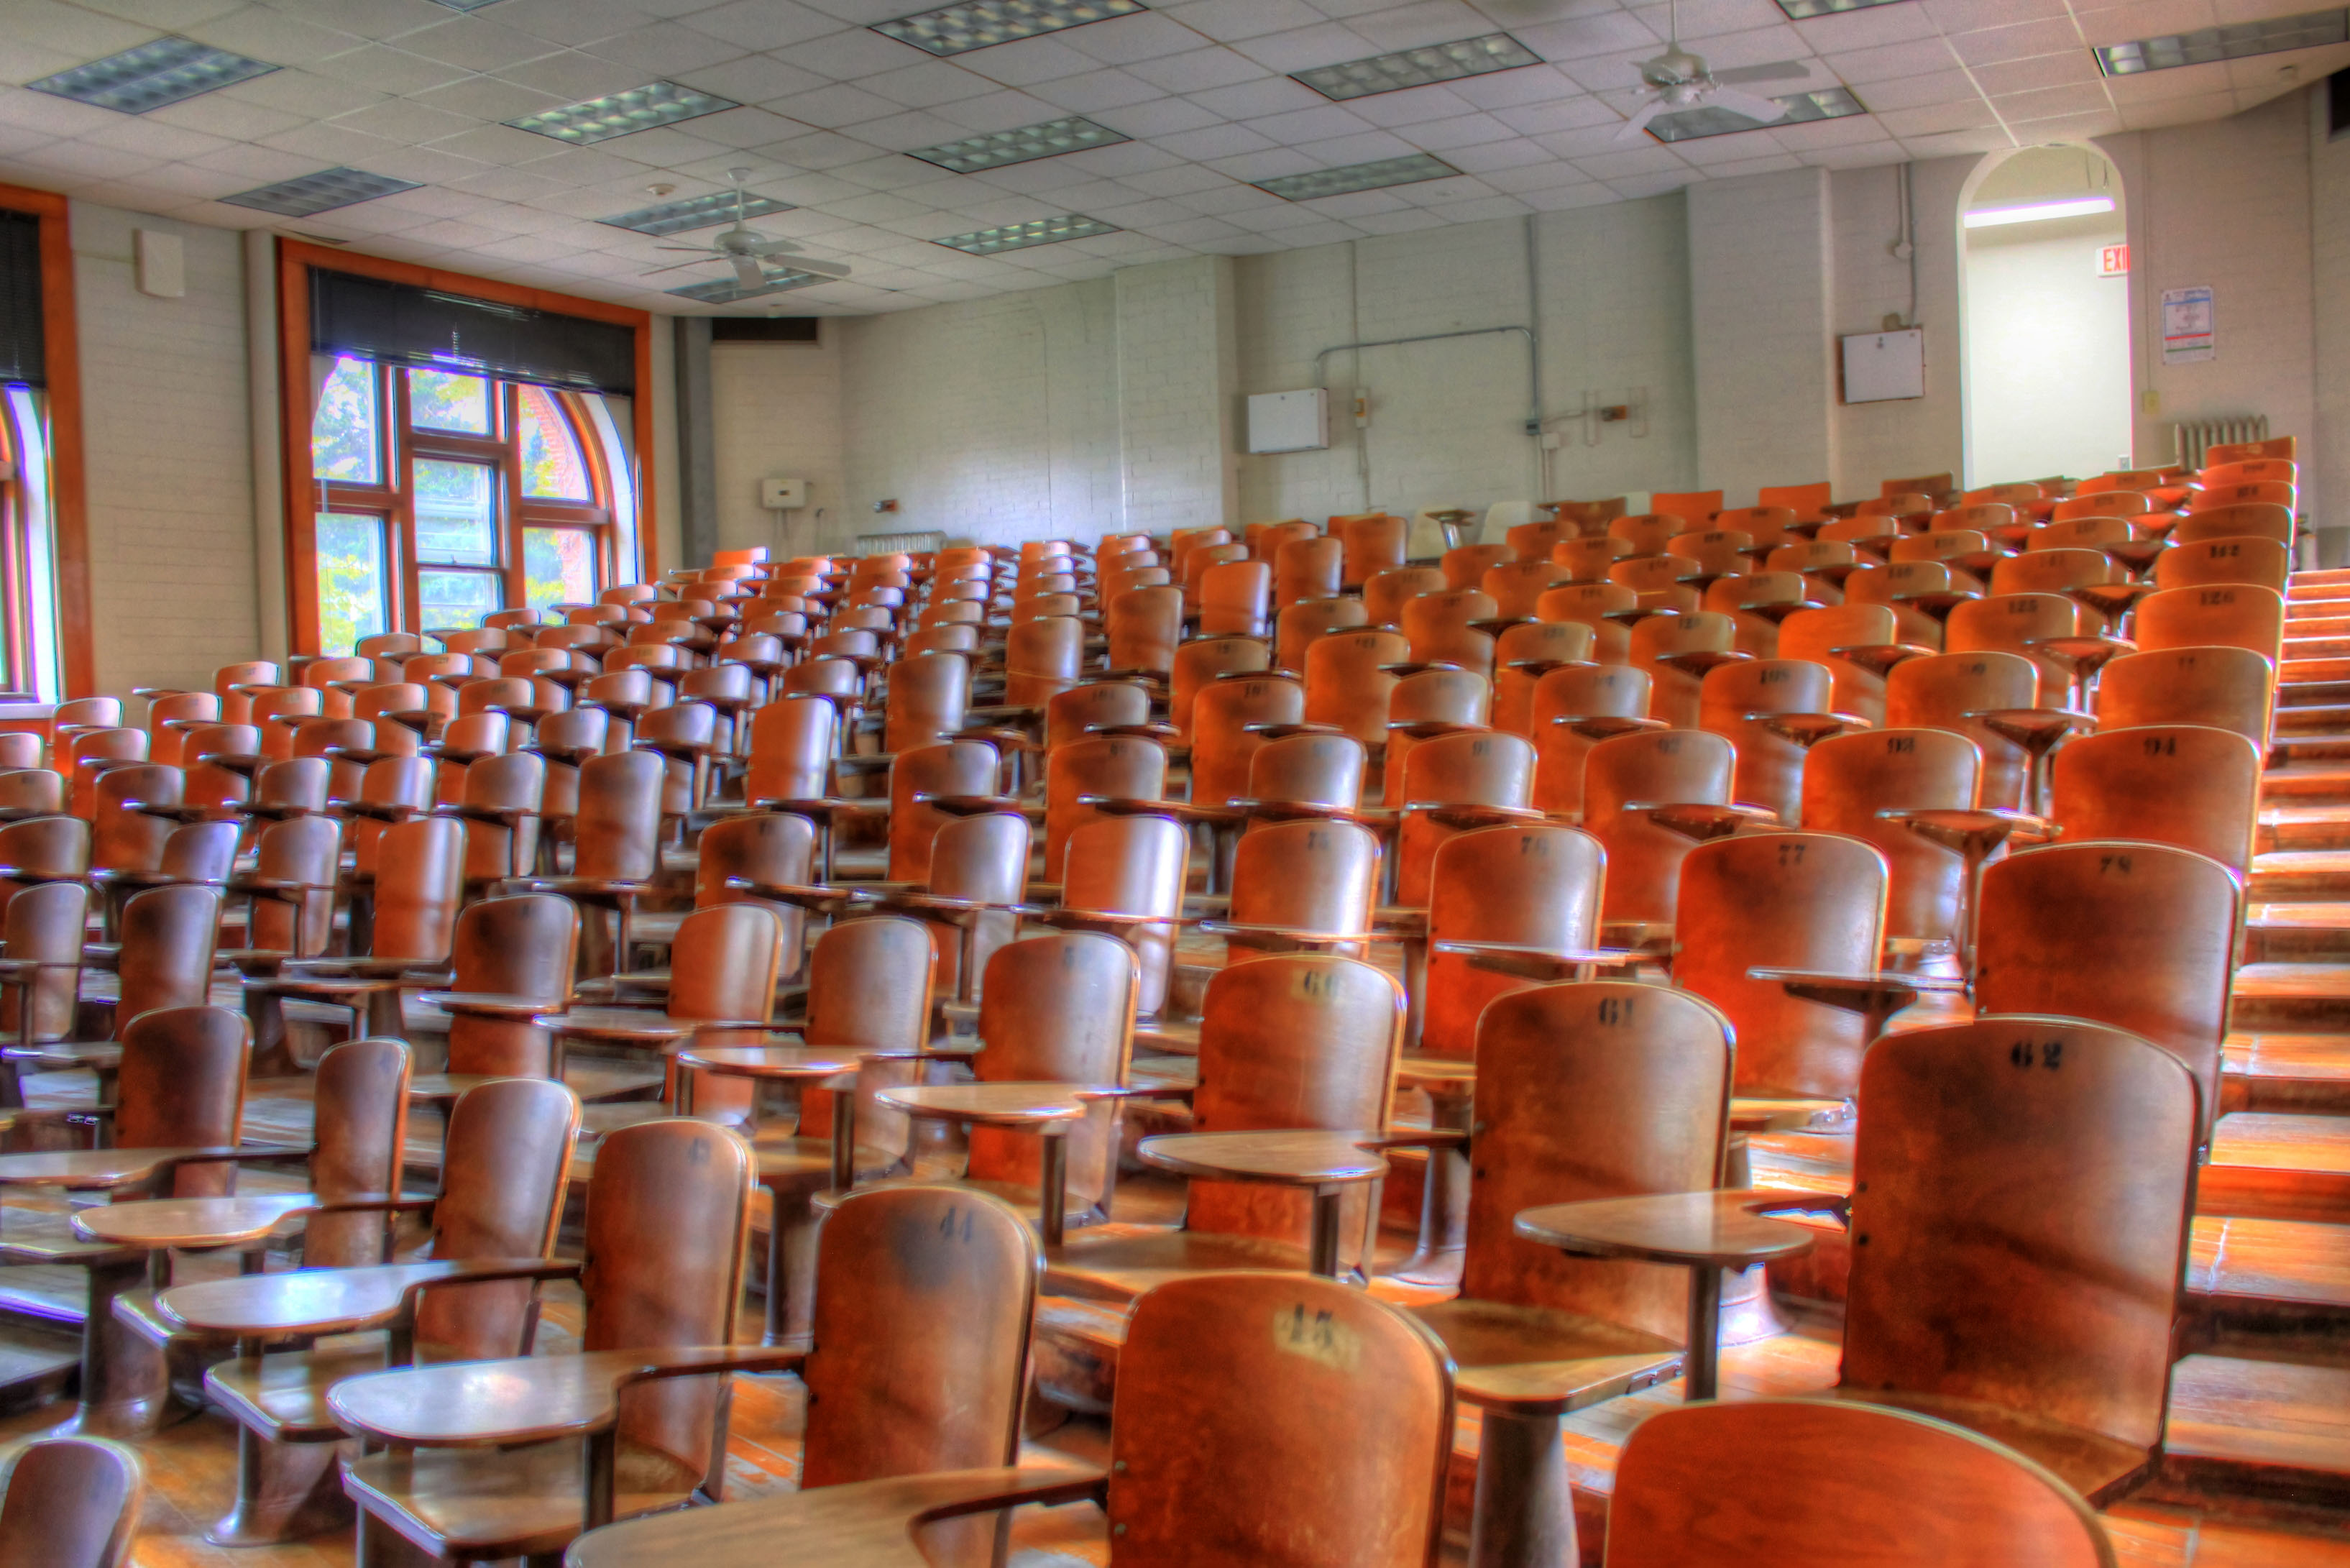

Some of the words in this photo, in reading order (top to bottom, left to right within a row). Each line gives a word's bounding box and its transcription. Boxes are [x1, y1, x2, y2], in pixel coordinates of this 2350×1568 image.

[2103, 247, 2130, 272] EXI
[1779, 844, 1805, 866] 77
[1599, 998, 1633, 1027] 61
[2011, 1041, 2061, 1070] 62
